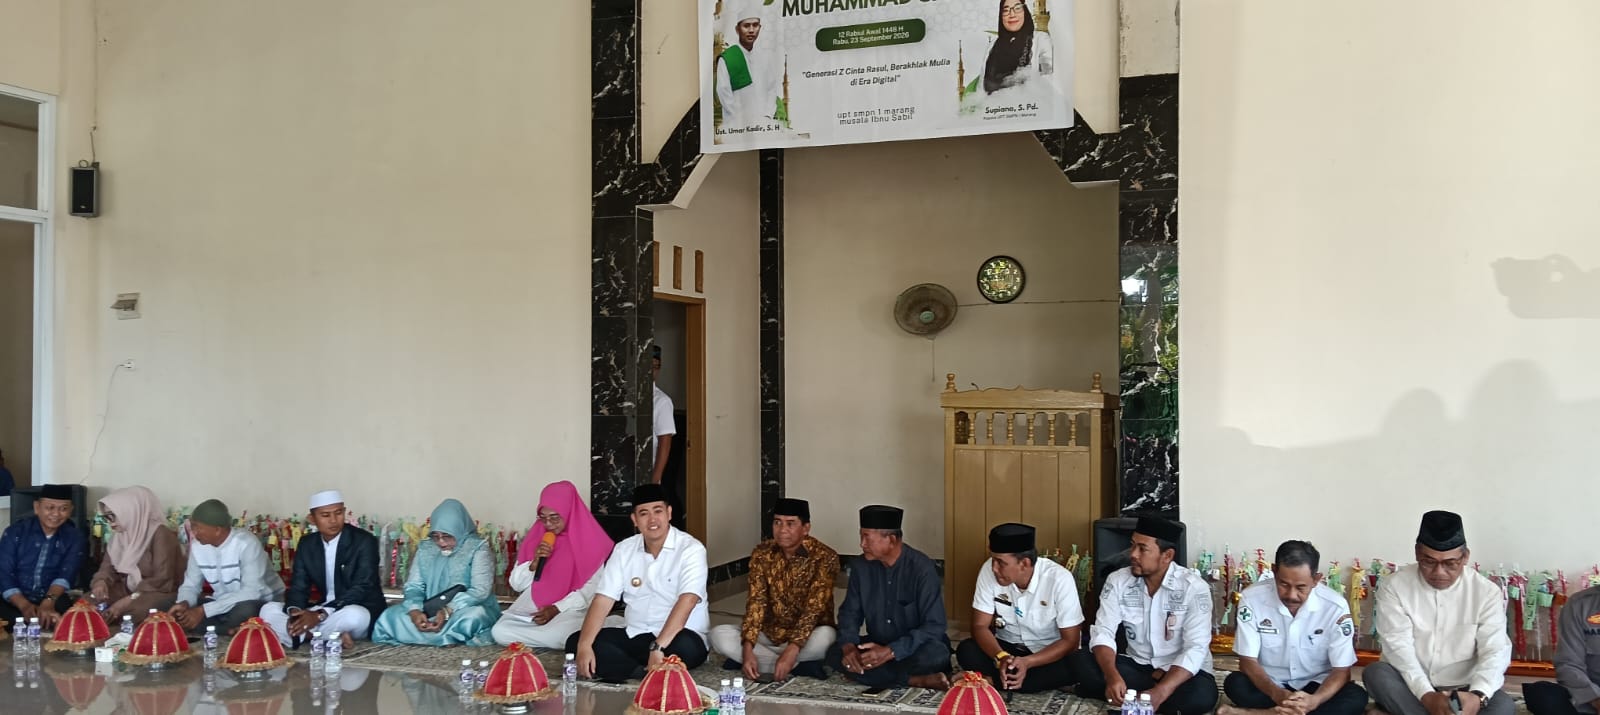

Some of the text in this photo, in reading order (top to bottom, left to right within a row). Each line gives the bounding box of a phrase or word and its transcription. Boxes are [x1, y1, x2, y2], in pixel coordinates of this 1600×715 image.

[782, 0, 911, 17] MUHAM
[859, 34, 892, 43] September
[802, 68, 837, 78] "Generasi
[845, 67, 865, 75] Cinta
[866, 64, 889, 73] Rasul,
[890, 60, 928, 71] Berakhlak
[929, 59, 951, 67] Mulia
[850, 74, 901, 86] di Era Digital"
[837, 111, 851, 119] upt
[853, 109, 876, 117] smpn
[884, 106, 915, 115] marang
[840, 113, 913, 125] musala Ibnu Sabil
